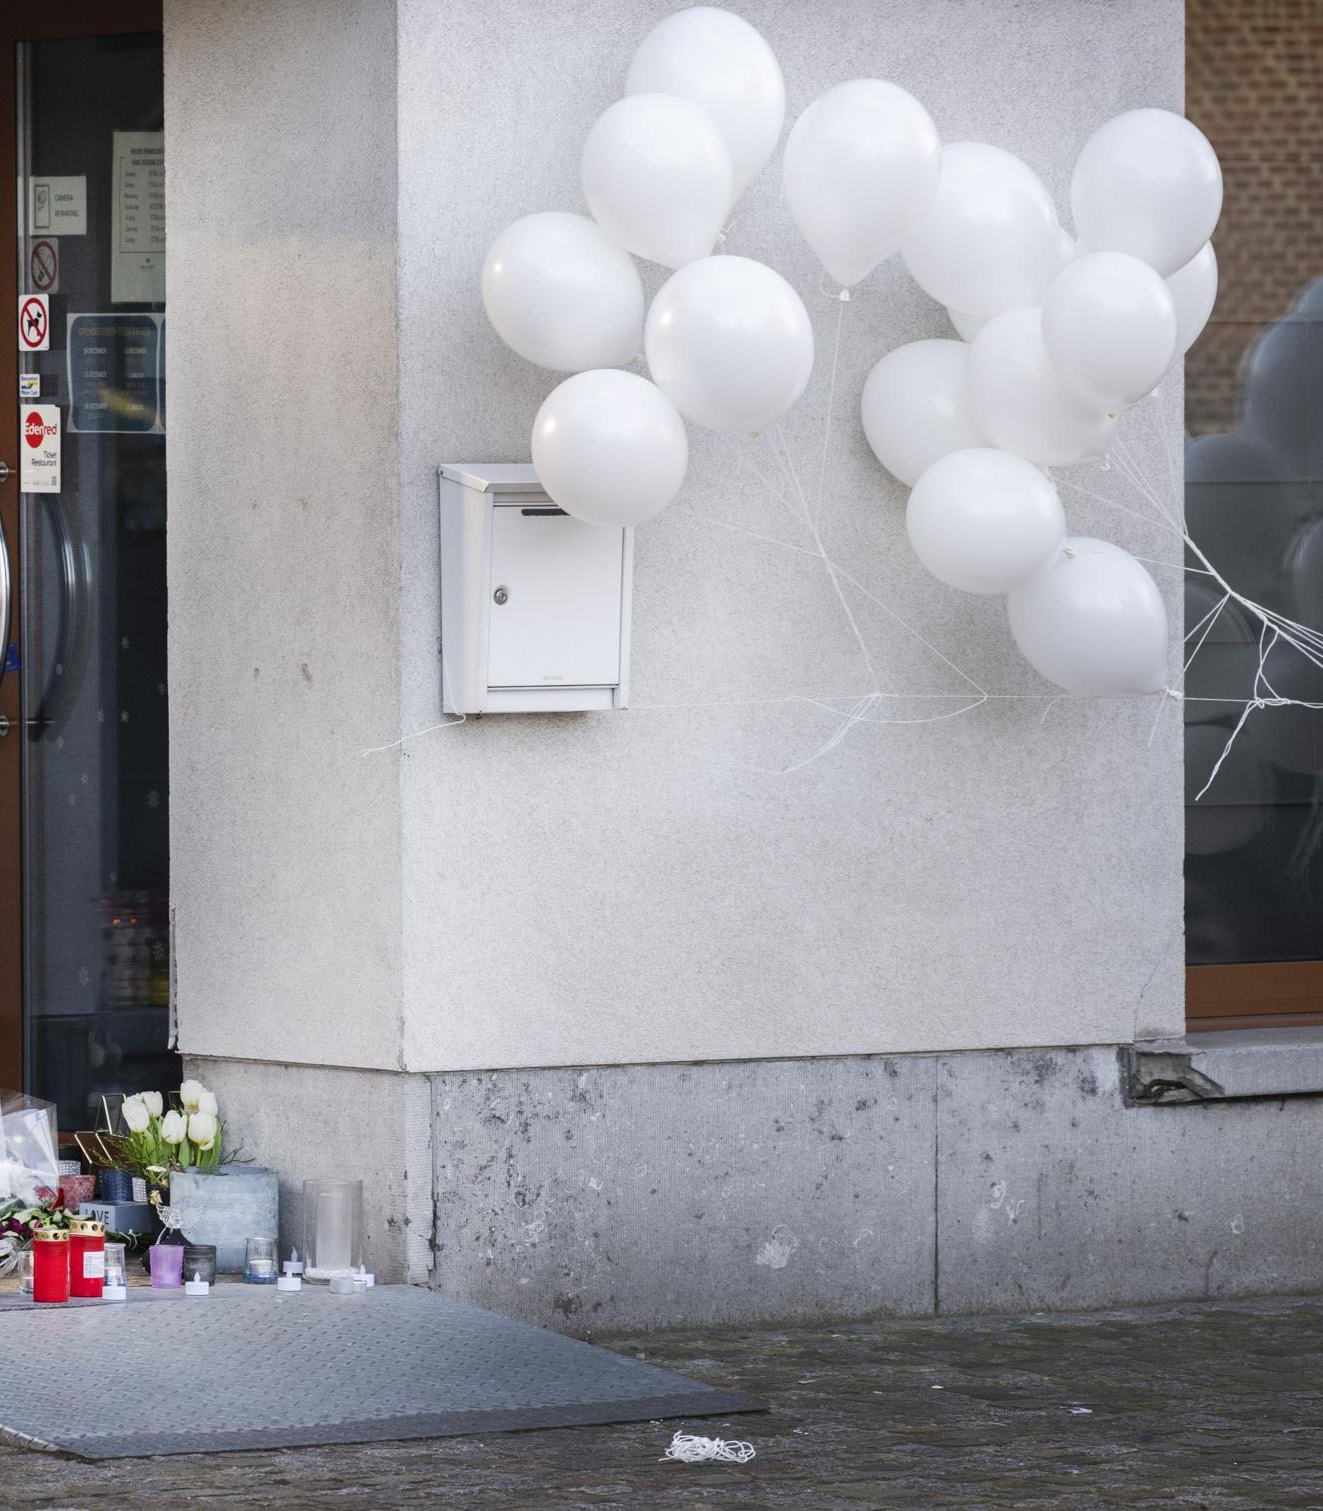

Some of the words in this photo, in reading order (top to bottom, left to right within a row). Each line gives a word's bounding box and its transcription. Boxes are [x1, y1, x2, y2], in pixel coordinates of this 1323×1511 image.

[25, 423, 57, 436] Edenred
[43, 450, 57, 459] Ticket
[31, 459, 57, 467] Restaurant
